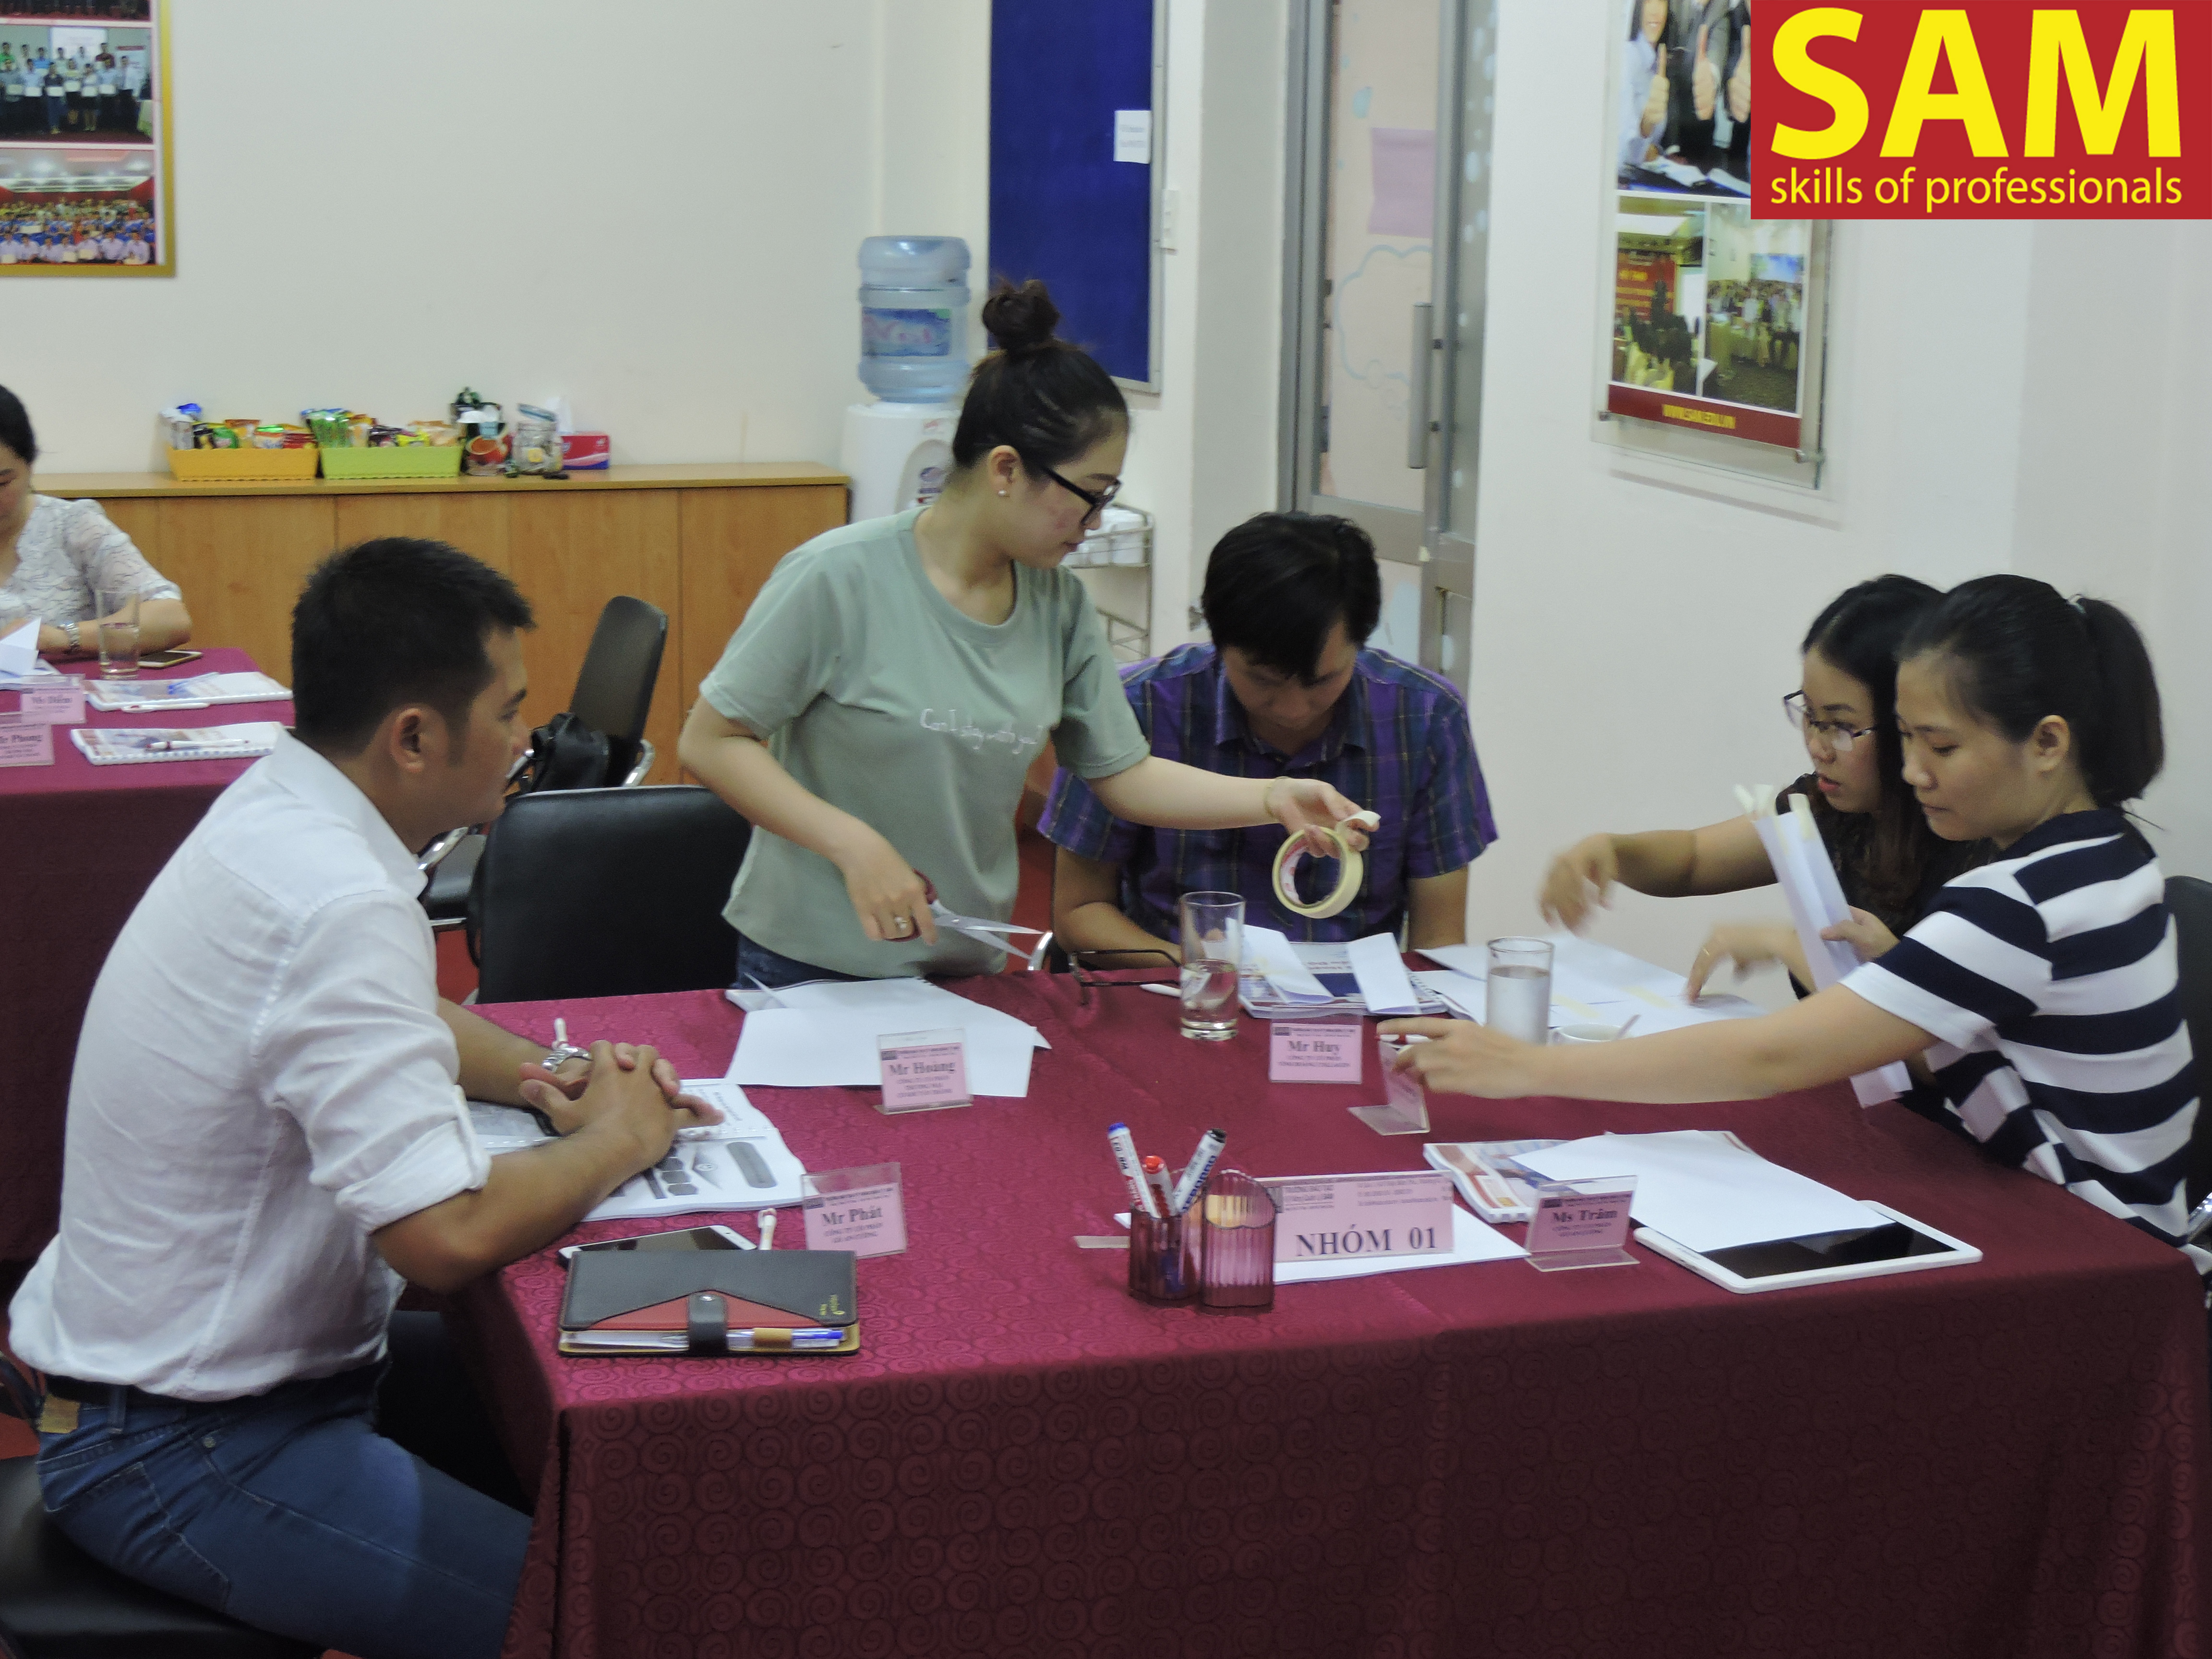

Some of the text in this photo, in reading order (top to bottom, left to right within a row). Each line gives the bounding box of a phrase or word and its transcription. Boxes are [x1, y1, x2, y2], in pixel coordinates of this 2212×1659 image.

[1288, 1040, 1341, 1055] Mr Huy
[889, 1063, 910, 1075] Mr
[820, 1212, 846, 1226] Mr
[1297, 1224, 1437, 1256] NHÓM 01
